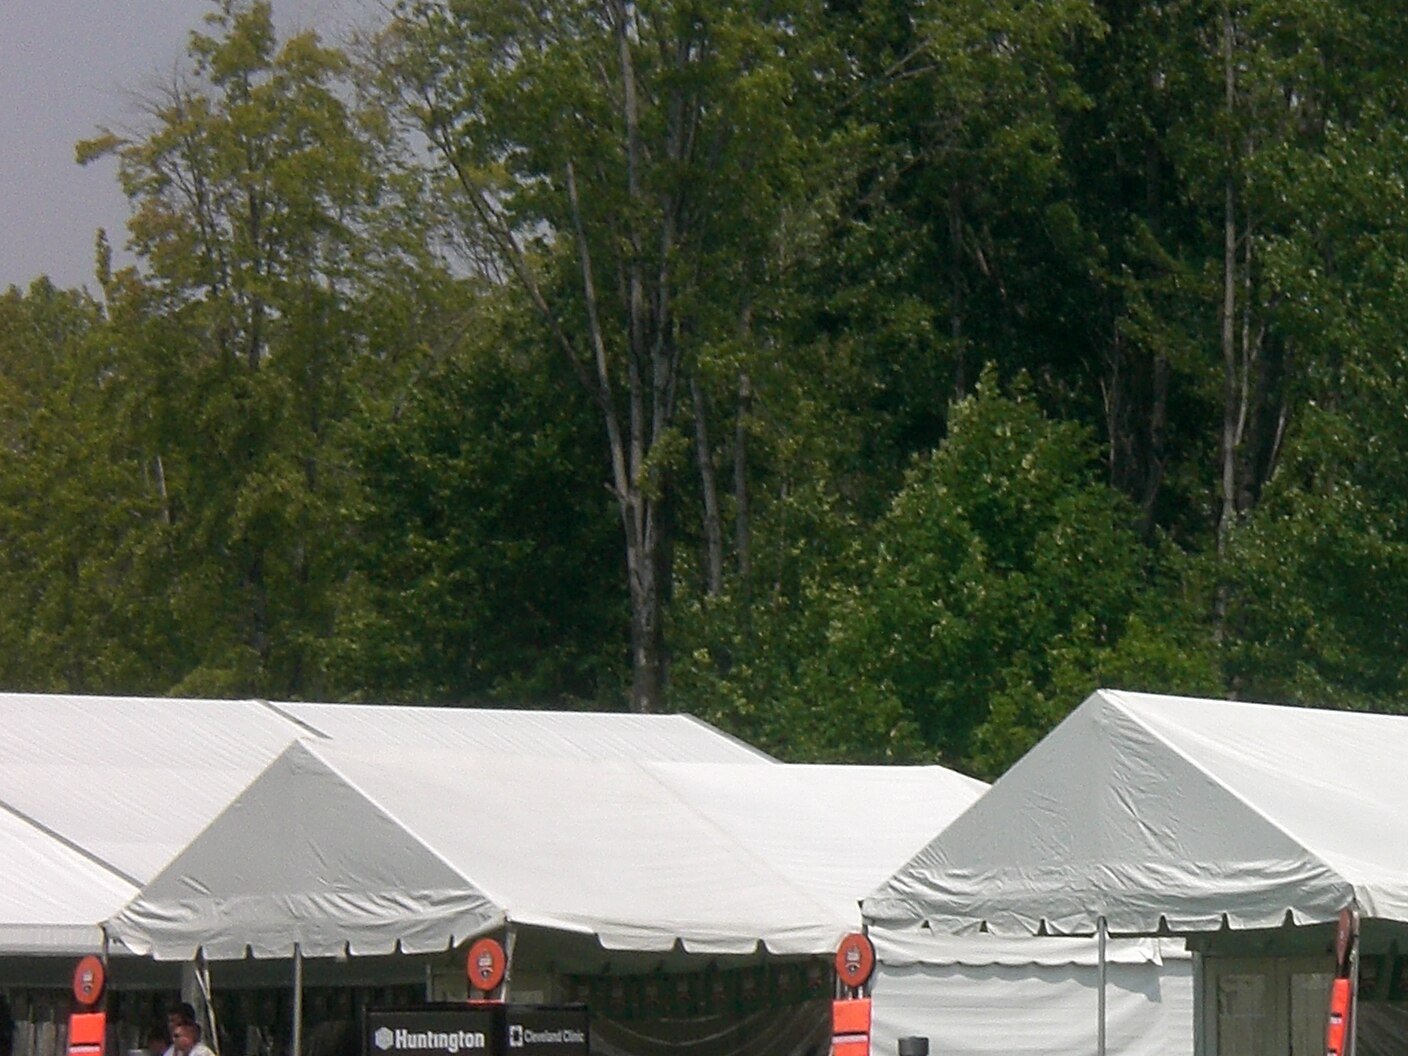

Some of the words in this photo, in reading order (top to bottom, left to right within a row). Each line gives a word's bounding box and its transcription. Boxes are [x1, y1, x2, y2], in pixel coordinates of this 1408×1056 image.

[395, 1029, 485, 1053] Huntington
[524, 1030, 562, 1043] Cleveland
[563, 1030, 585, 1043] Clinic
